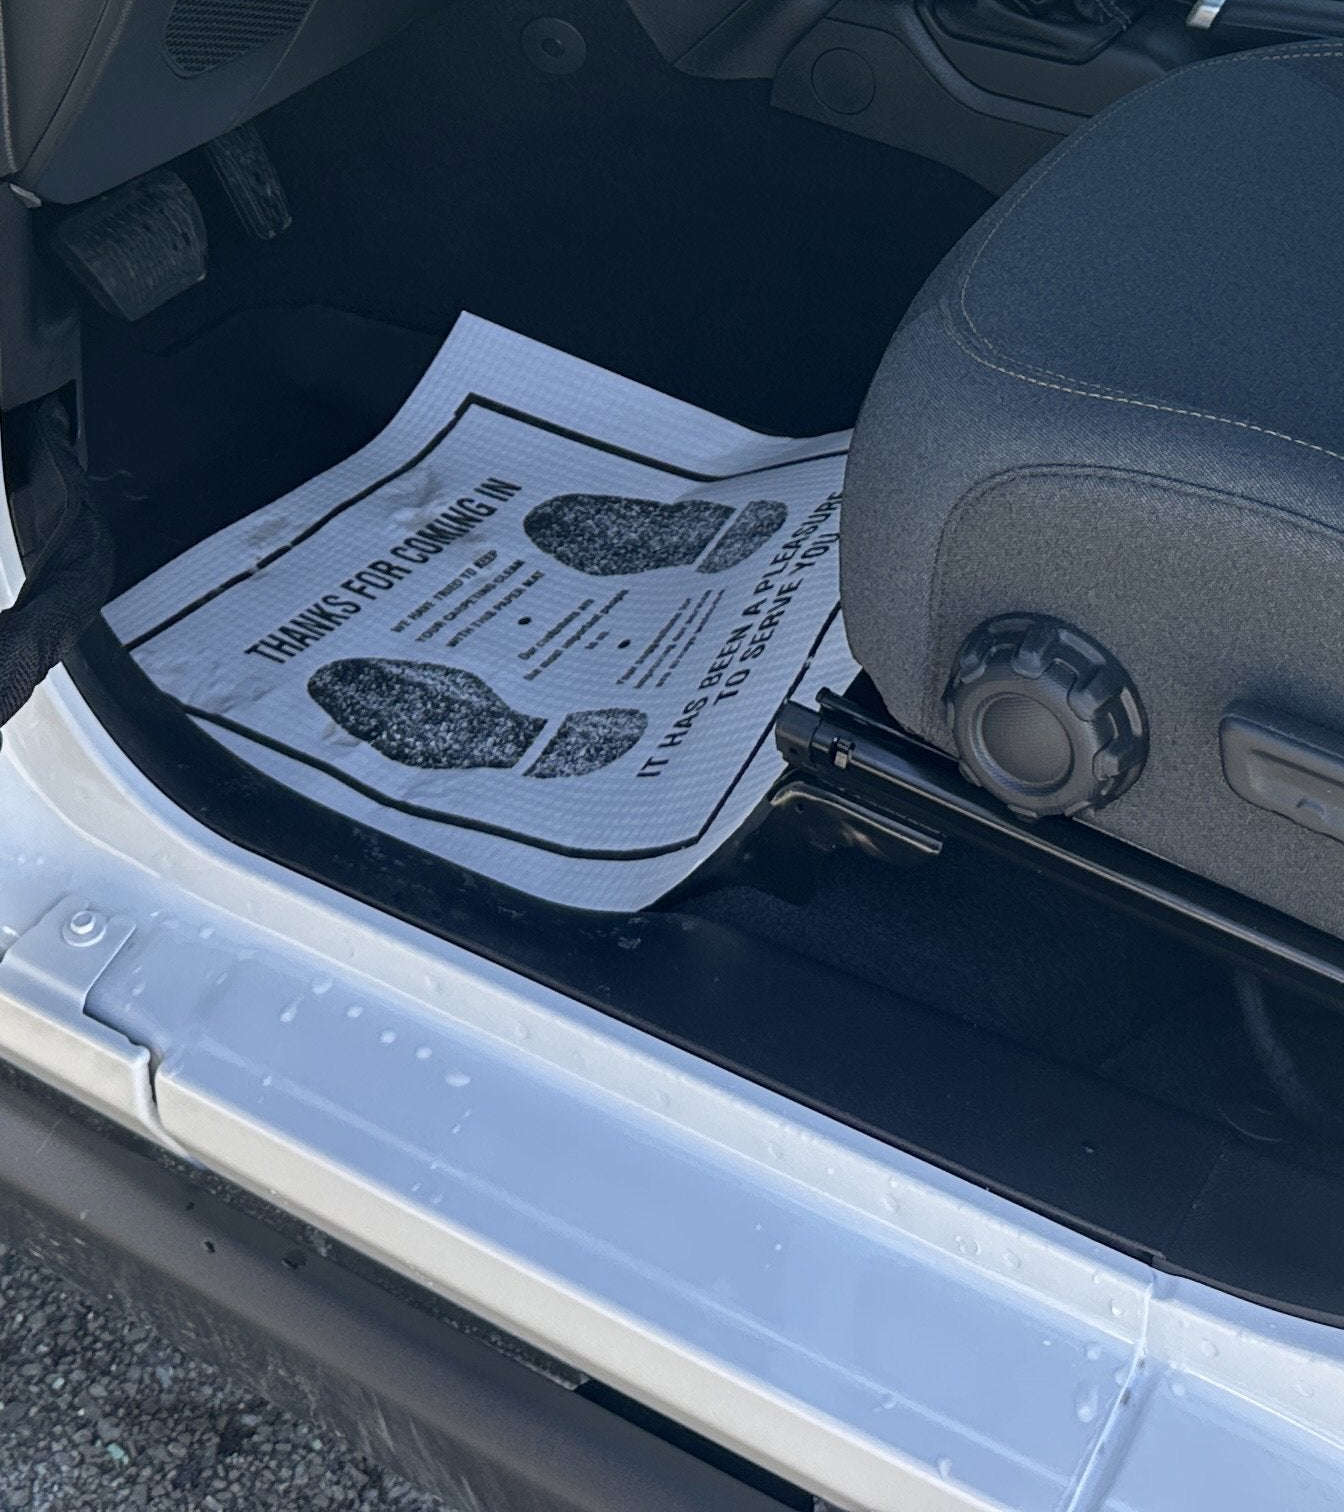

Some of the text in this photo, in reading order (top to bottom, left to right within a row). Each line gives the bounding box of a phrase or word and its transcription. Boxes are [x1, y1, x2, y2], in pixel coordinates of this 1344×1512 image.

[244, 476, 523, 664] THANKS FOR COMING IN
[713, 532, 841, 706] TO SERVE YOU
[636, 756, 669, 778] IT
[658, 695, 709, 748] HAS
[698, 622, 753, 690] BEEN
[742, 597, 768, 617] A
